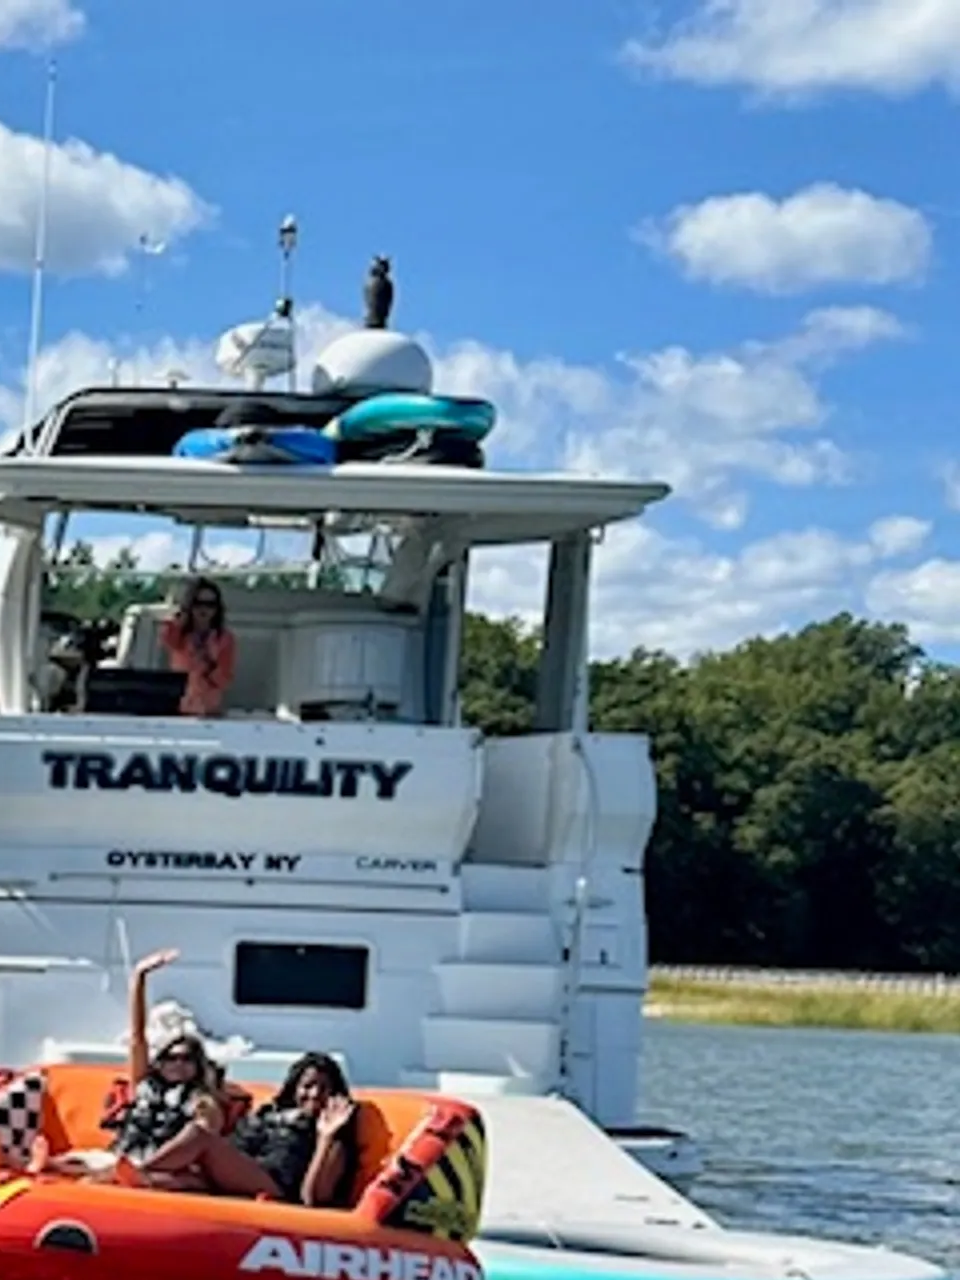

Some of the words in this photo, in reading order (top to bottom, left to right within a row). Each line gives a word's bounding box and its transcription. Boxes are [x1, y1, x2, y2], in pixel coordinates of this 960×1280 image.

[42, 750, 413, 800] TRANQUILITY
[264, 853, 302, 873] NY
[356, 855, 437, 873] CARVER
